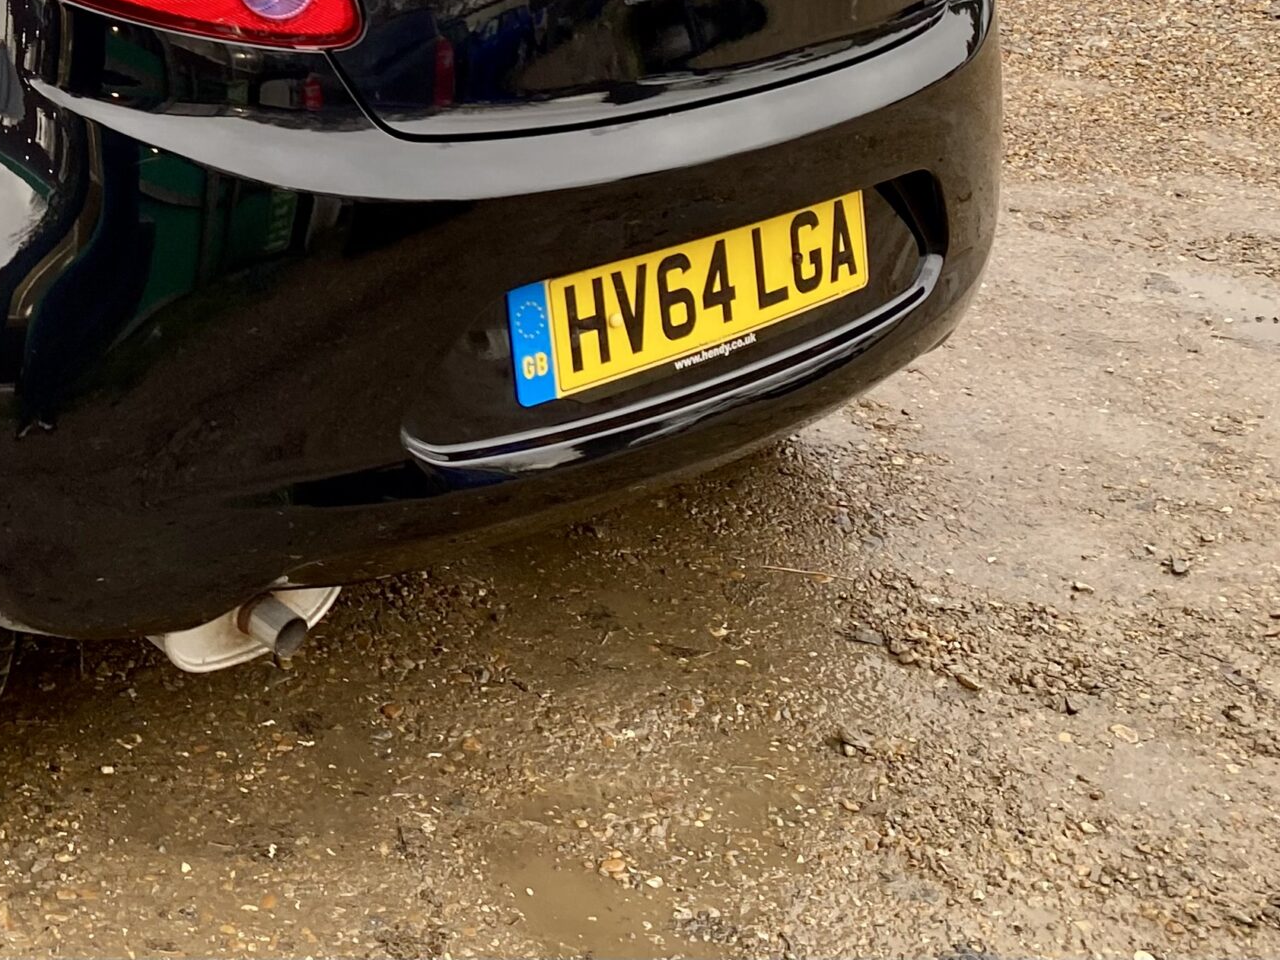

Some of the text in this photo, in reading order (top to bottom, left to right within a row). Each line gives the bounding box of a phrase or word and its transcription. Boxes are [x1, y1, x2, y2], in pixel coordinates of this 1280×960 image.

[564, 199, 858, 373] HV64 LGA
[522, 351, 549, 380] GB
[674, 332, 757, 370] www.hendy.co.uk
